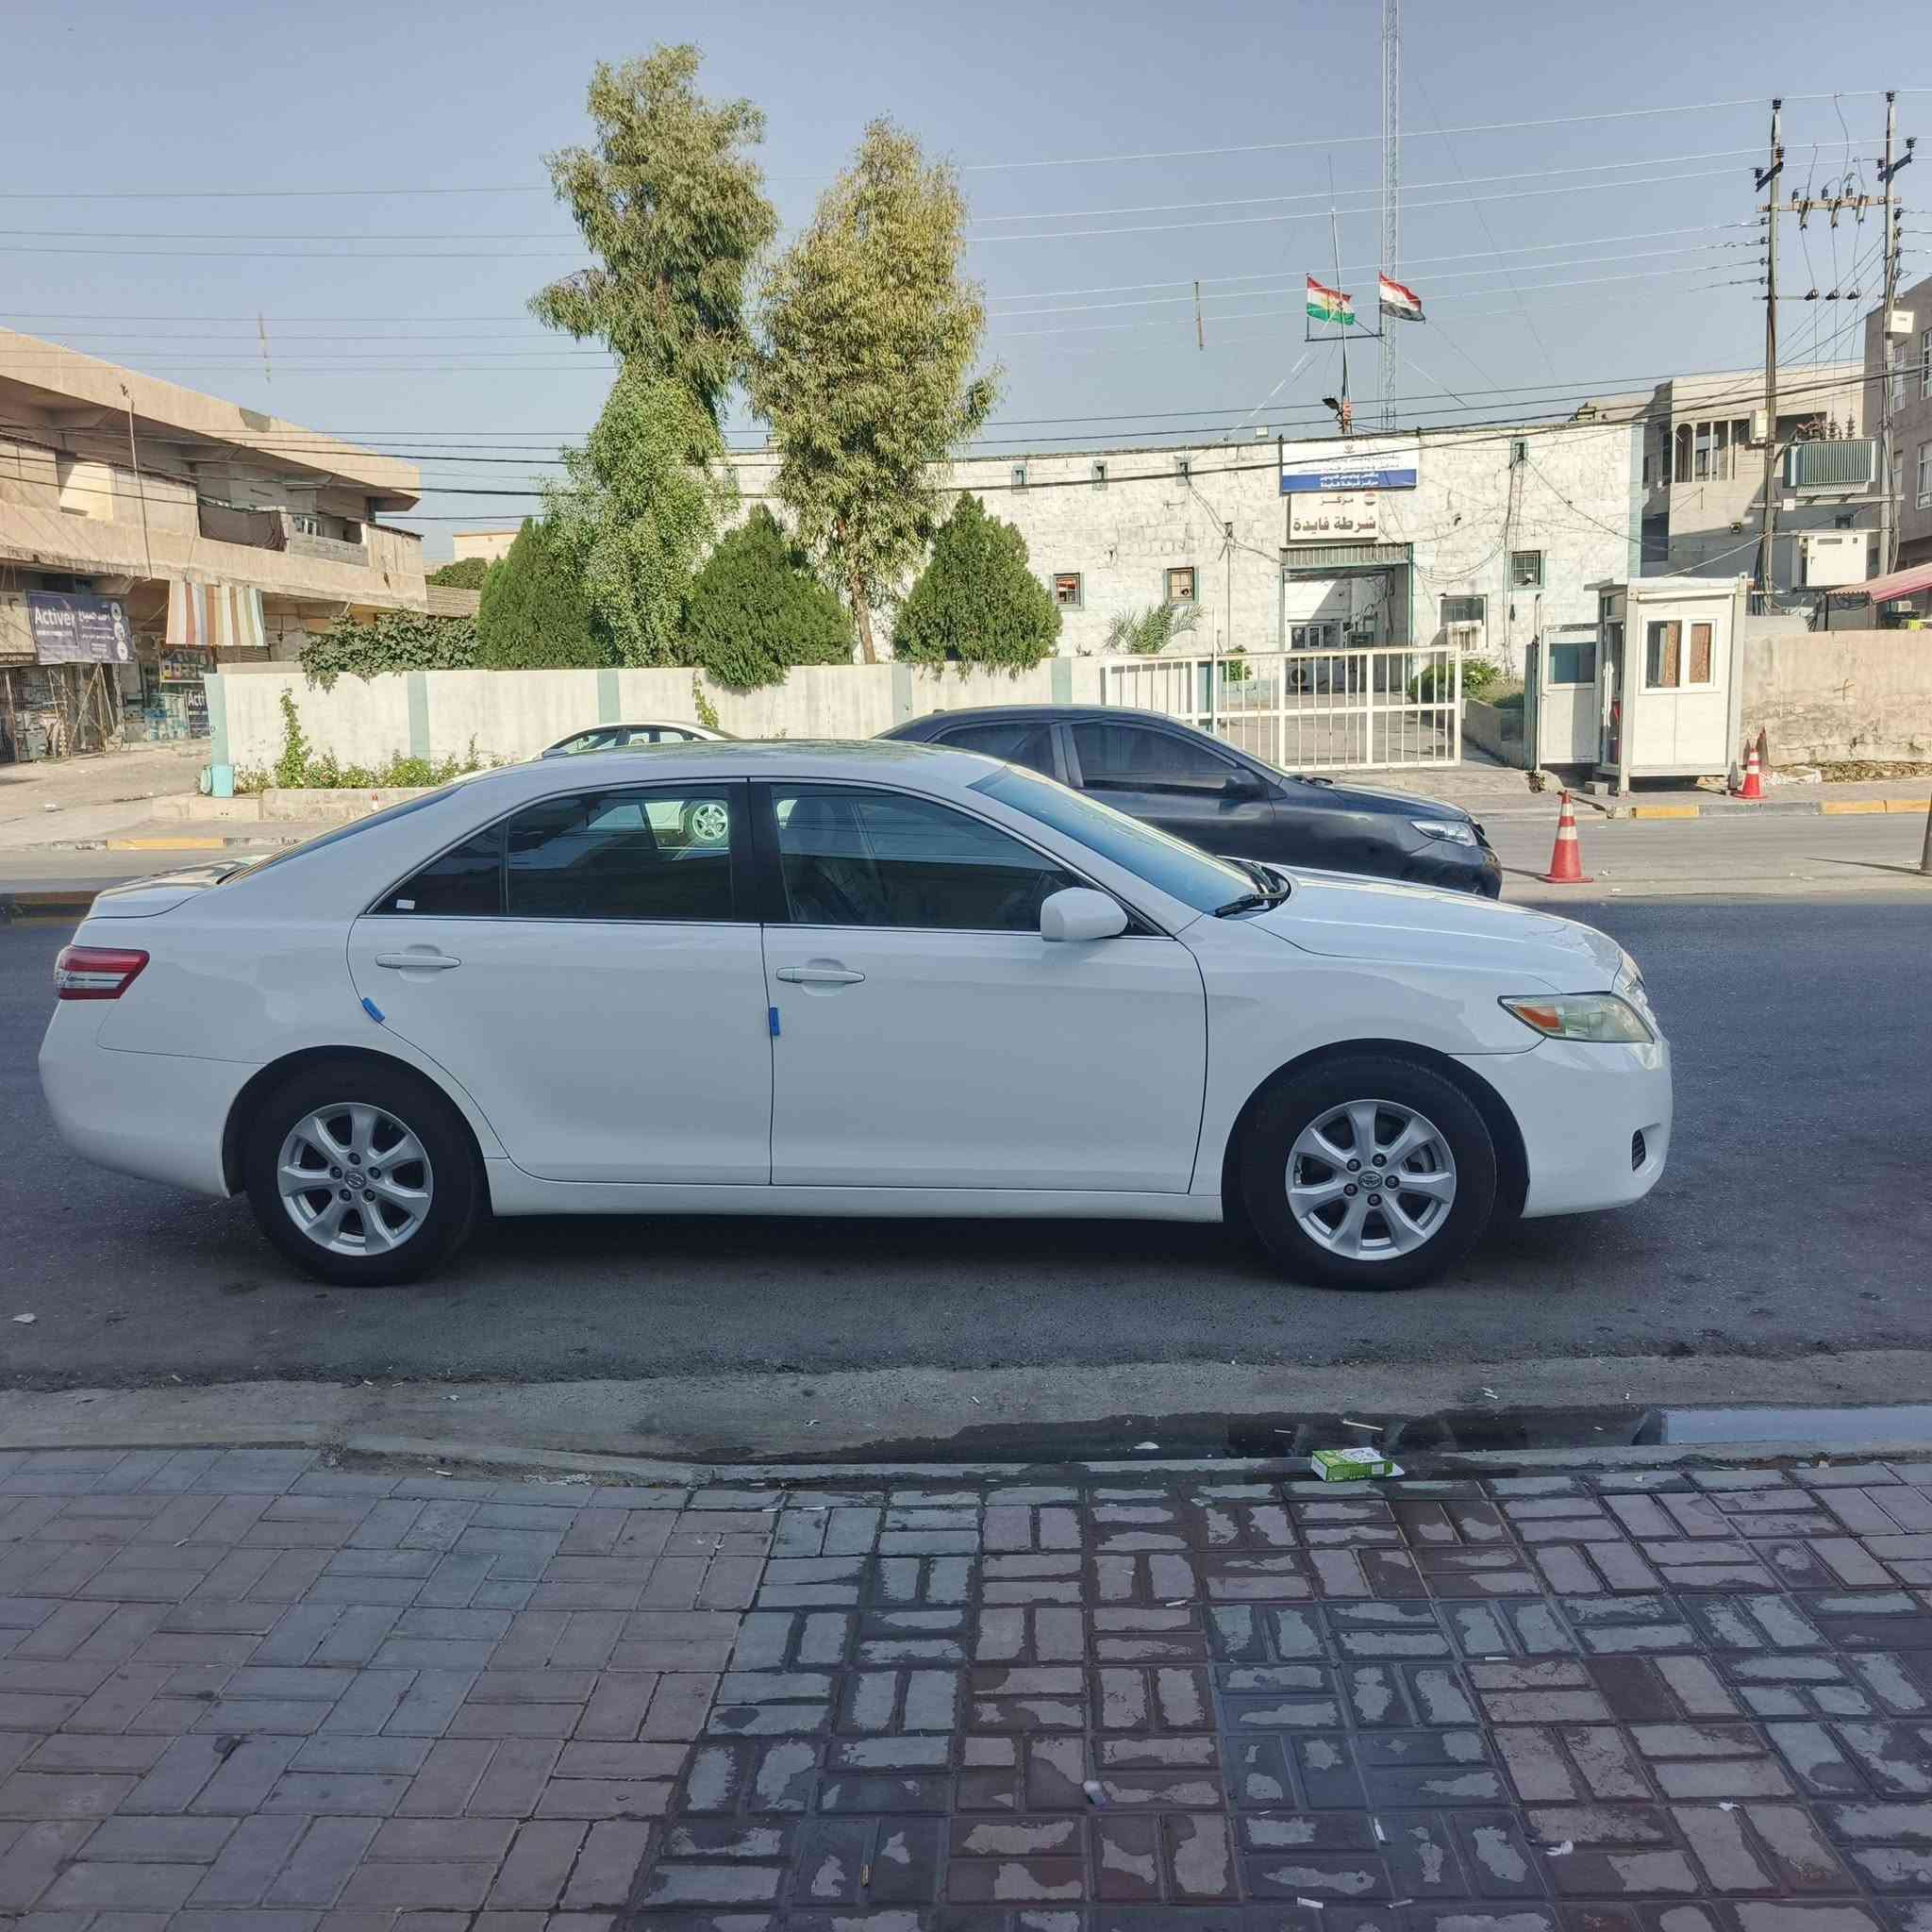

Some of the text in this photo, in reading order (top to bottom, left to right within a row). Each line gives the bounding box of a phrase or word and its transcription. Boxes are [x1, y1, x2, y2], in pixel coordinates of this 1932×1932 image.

[1321, 495, 1354, 506] مركز
[1293, 515, 1375, 534] شرطة فايدة
[188, 691, 206, 707] Acti
